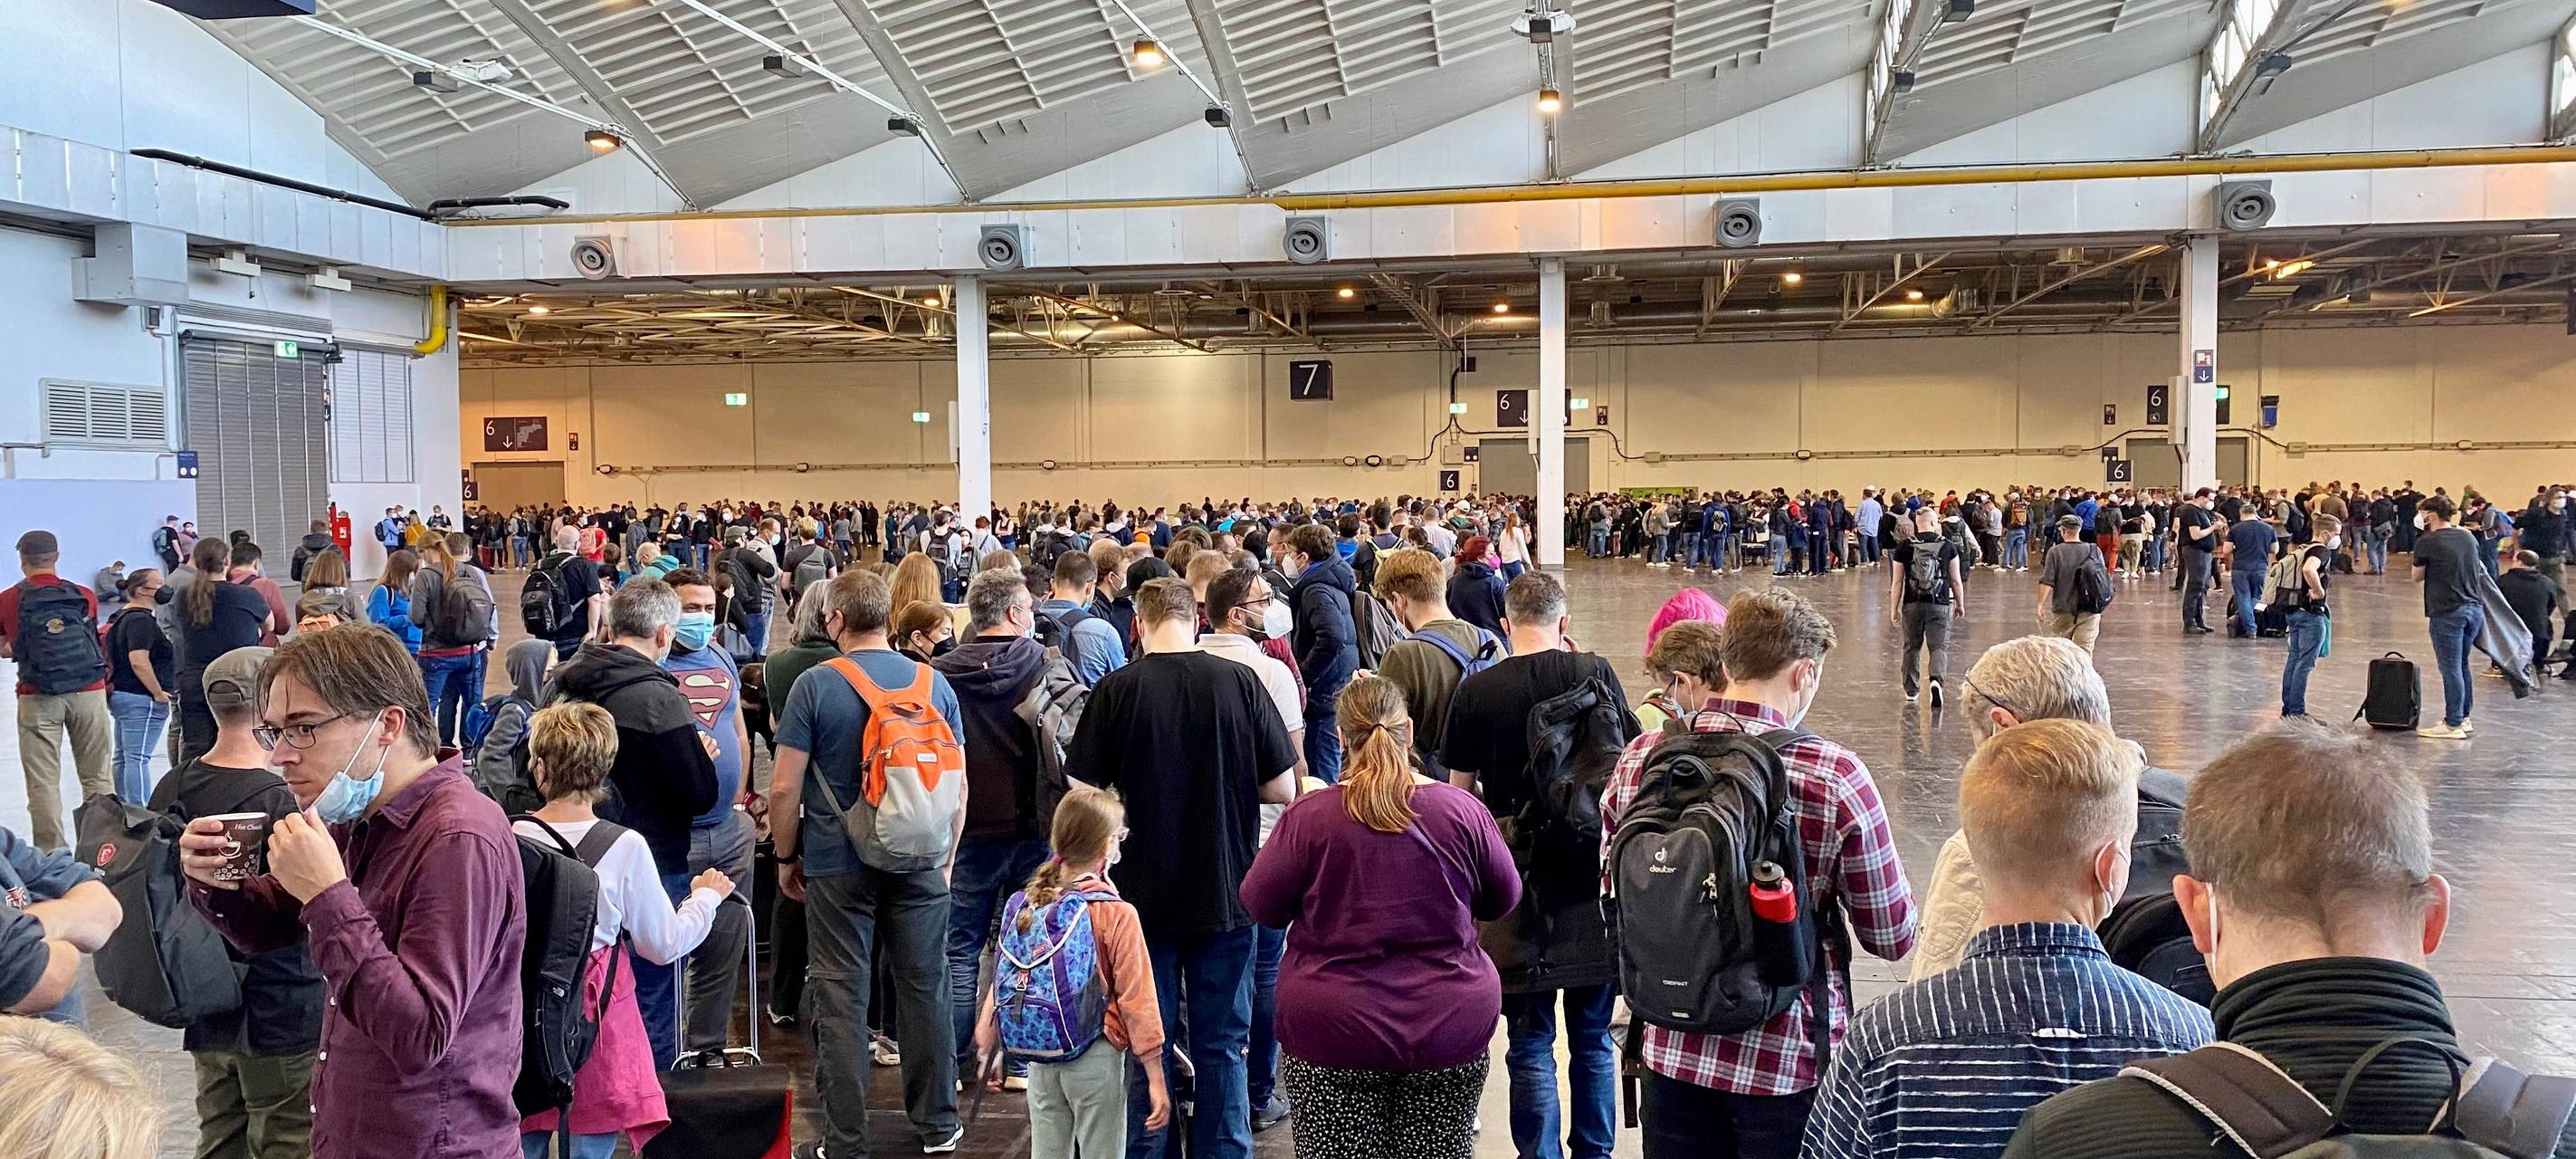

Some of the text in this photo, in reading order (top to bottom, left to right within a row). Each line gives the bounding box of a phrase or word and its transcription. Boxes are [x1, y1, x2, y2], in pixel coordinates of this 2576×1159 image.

[1298, 364, 1319, 396] 7
[1500, 393, 1511, 410] 6
[2151, 389, 2161, 407] 6
[486, 420, 495, 436] 6
[2113, 463, 2124, 479] 6
[1446, 474, 1455, 488] 6
[463, 484, 472, 499] 6
[1649, 865, 1677, 873] deuter
